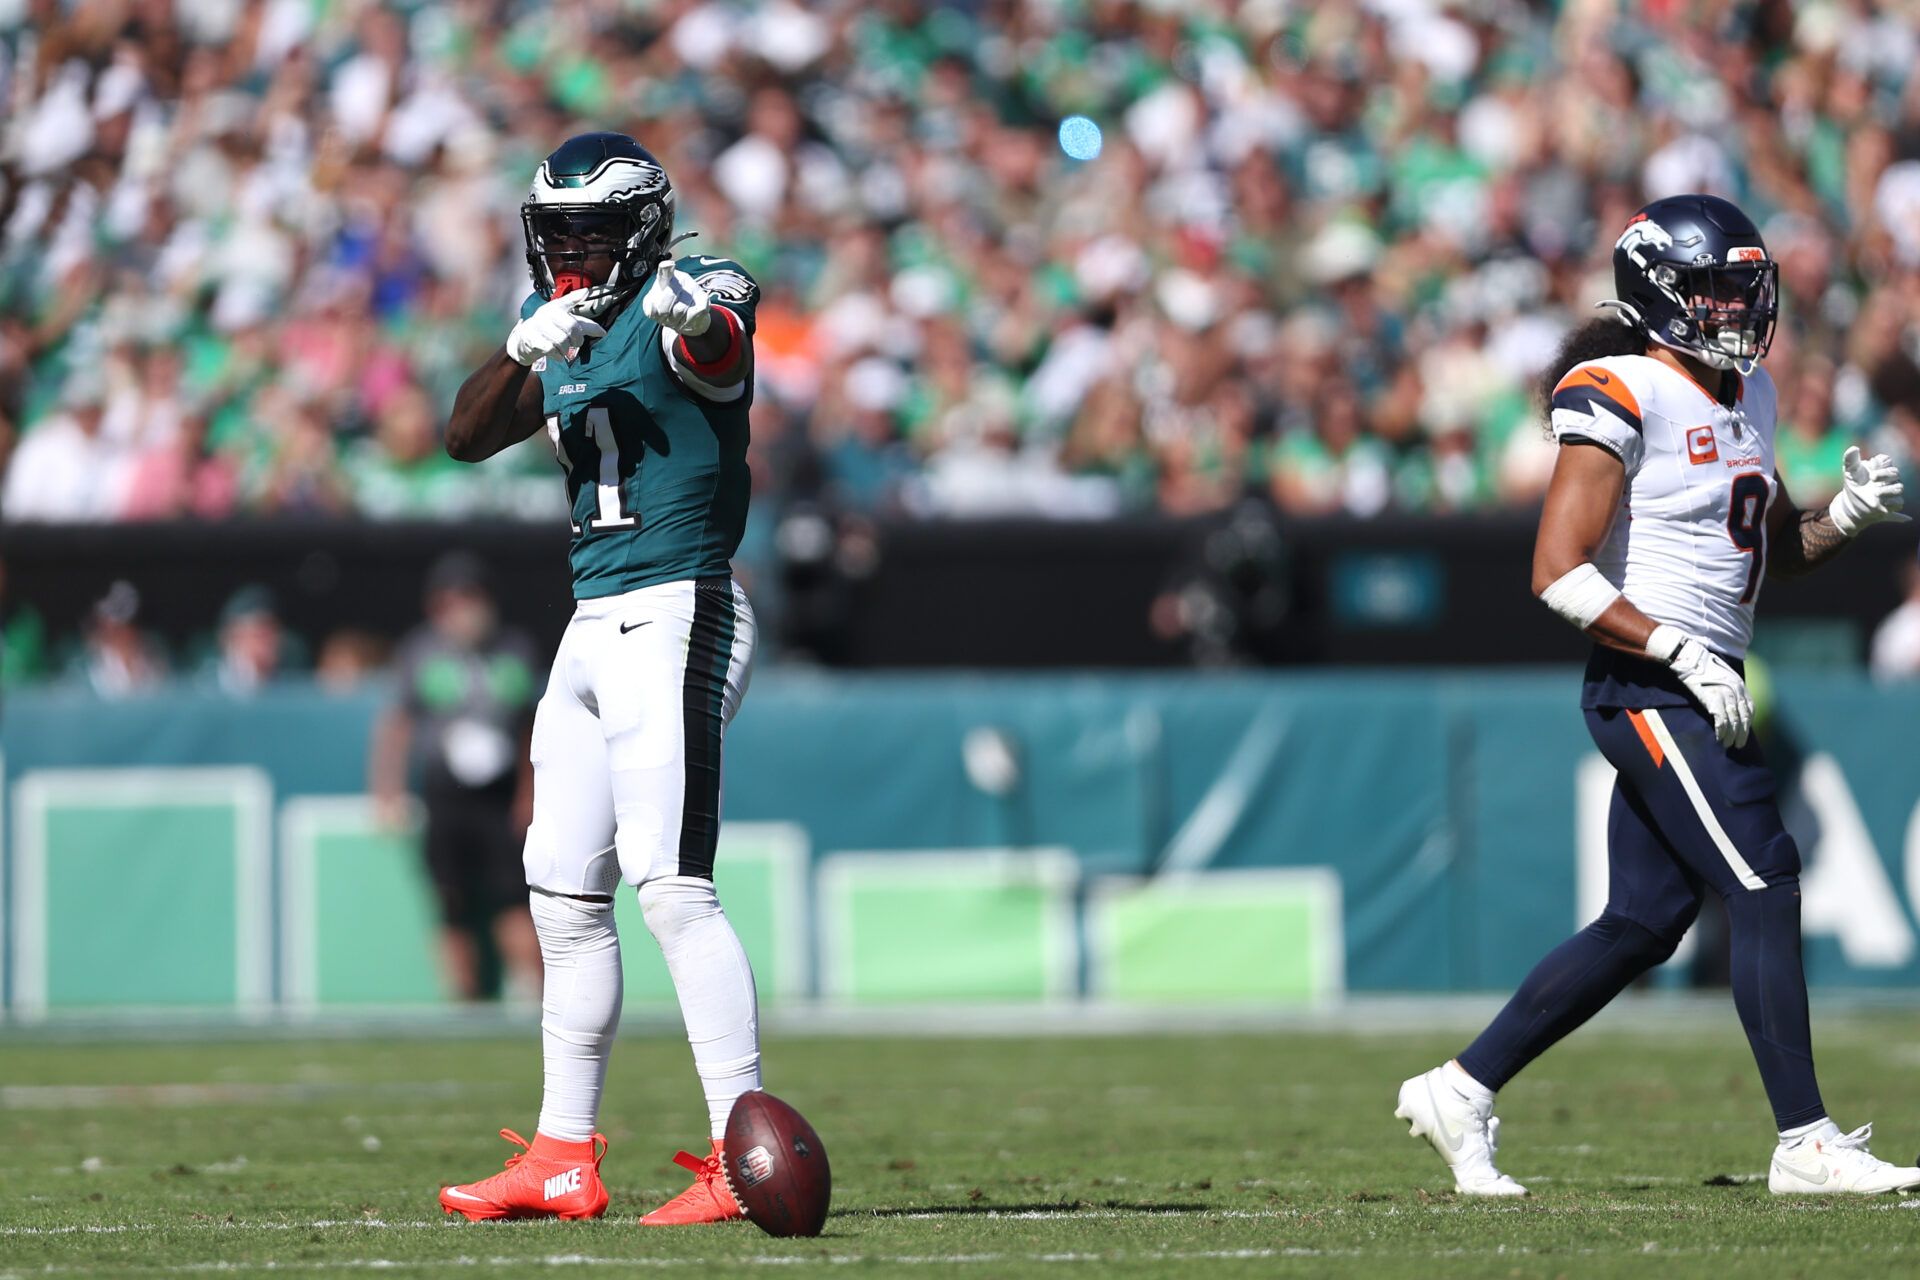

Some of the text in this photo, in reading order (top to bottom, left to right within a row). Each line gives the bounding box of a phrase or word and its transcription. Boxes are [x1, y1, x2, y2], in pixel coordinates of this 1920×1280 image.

[558, 383, 587, 395] EAGLES
[1689, 428, 1715, 456] C
[1727, 472, 1769, 604] 9
[543, 1166, 581, 1202] NIKE
